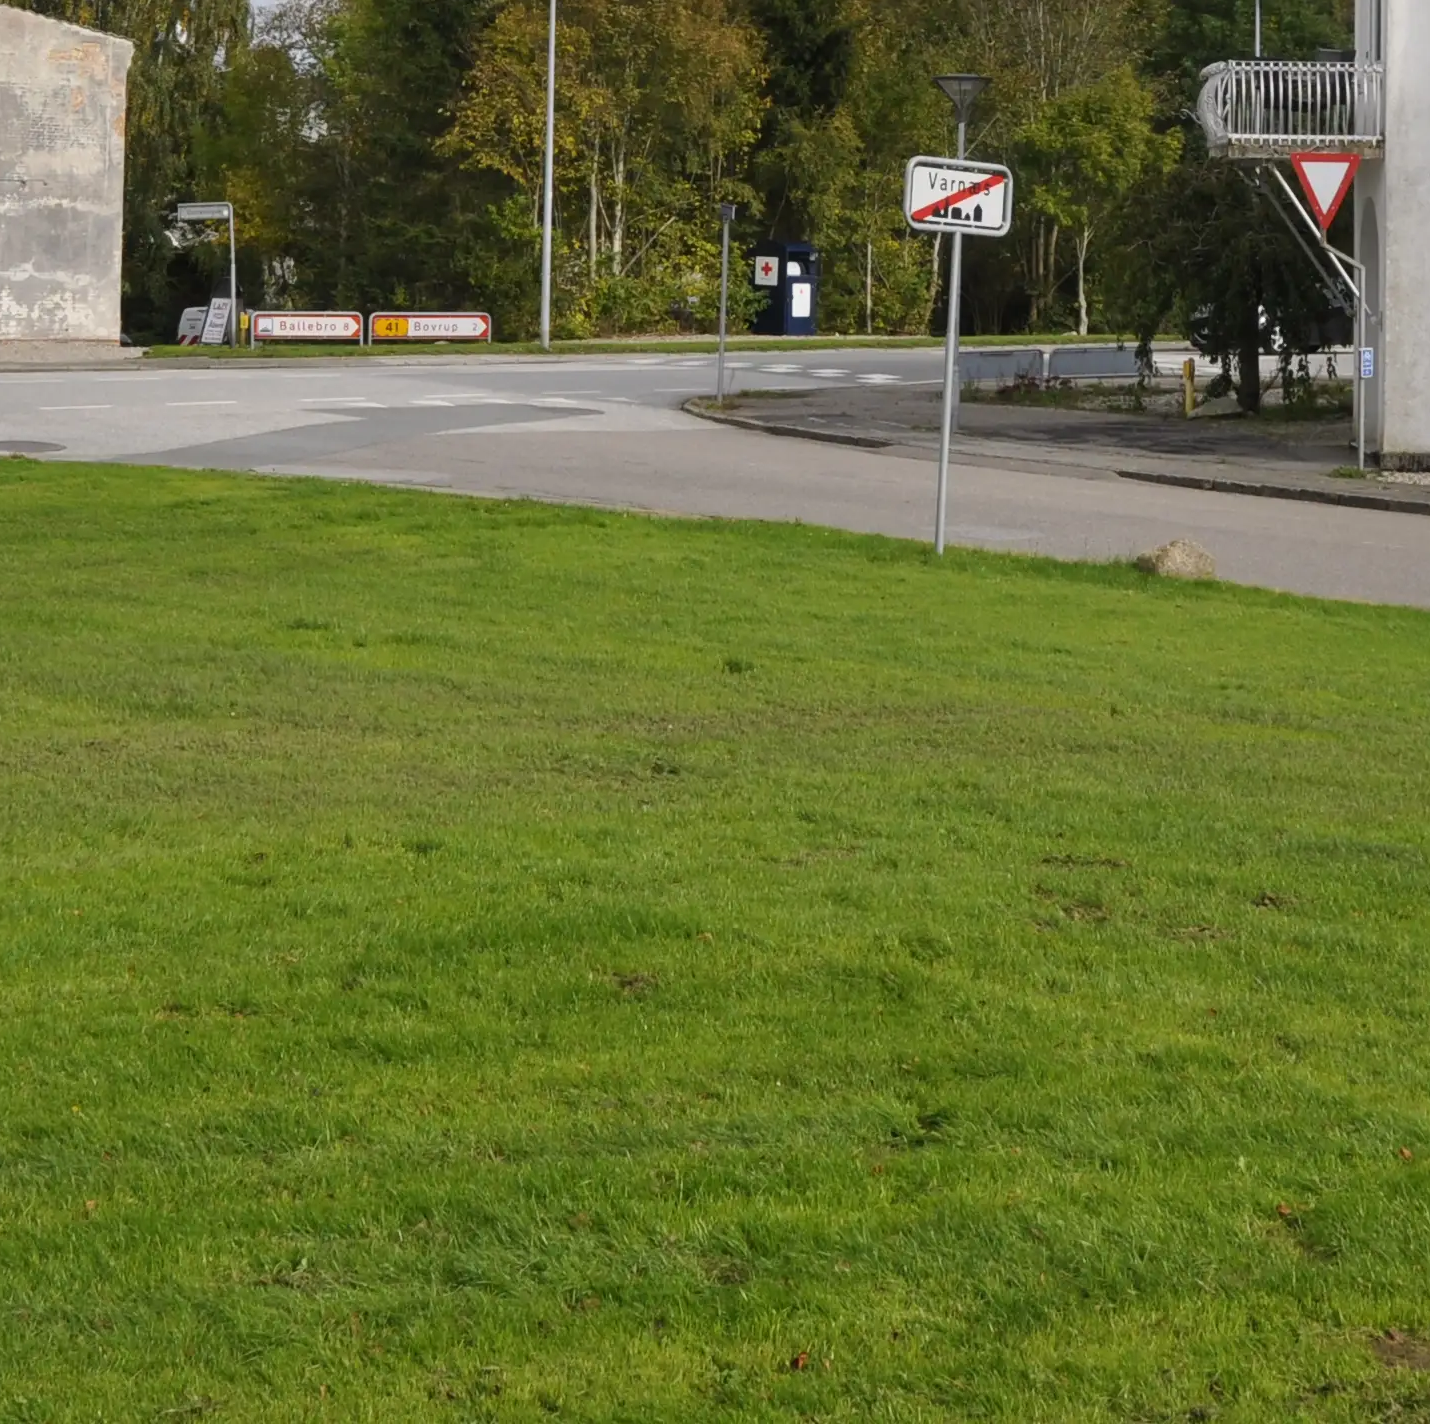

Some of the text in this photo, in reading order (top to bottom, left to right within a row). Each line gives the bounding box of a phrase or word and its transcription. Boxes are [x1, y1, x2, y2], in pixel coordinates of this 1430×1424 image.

[928, 171, 991, 196] Varnæs
[279, 320, 350, 332] Ballebro 8
[385, 321, 479, 333] 41 Bovrup 2
